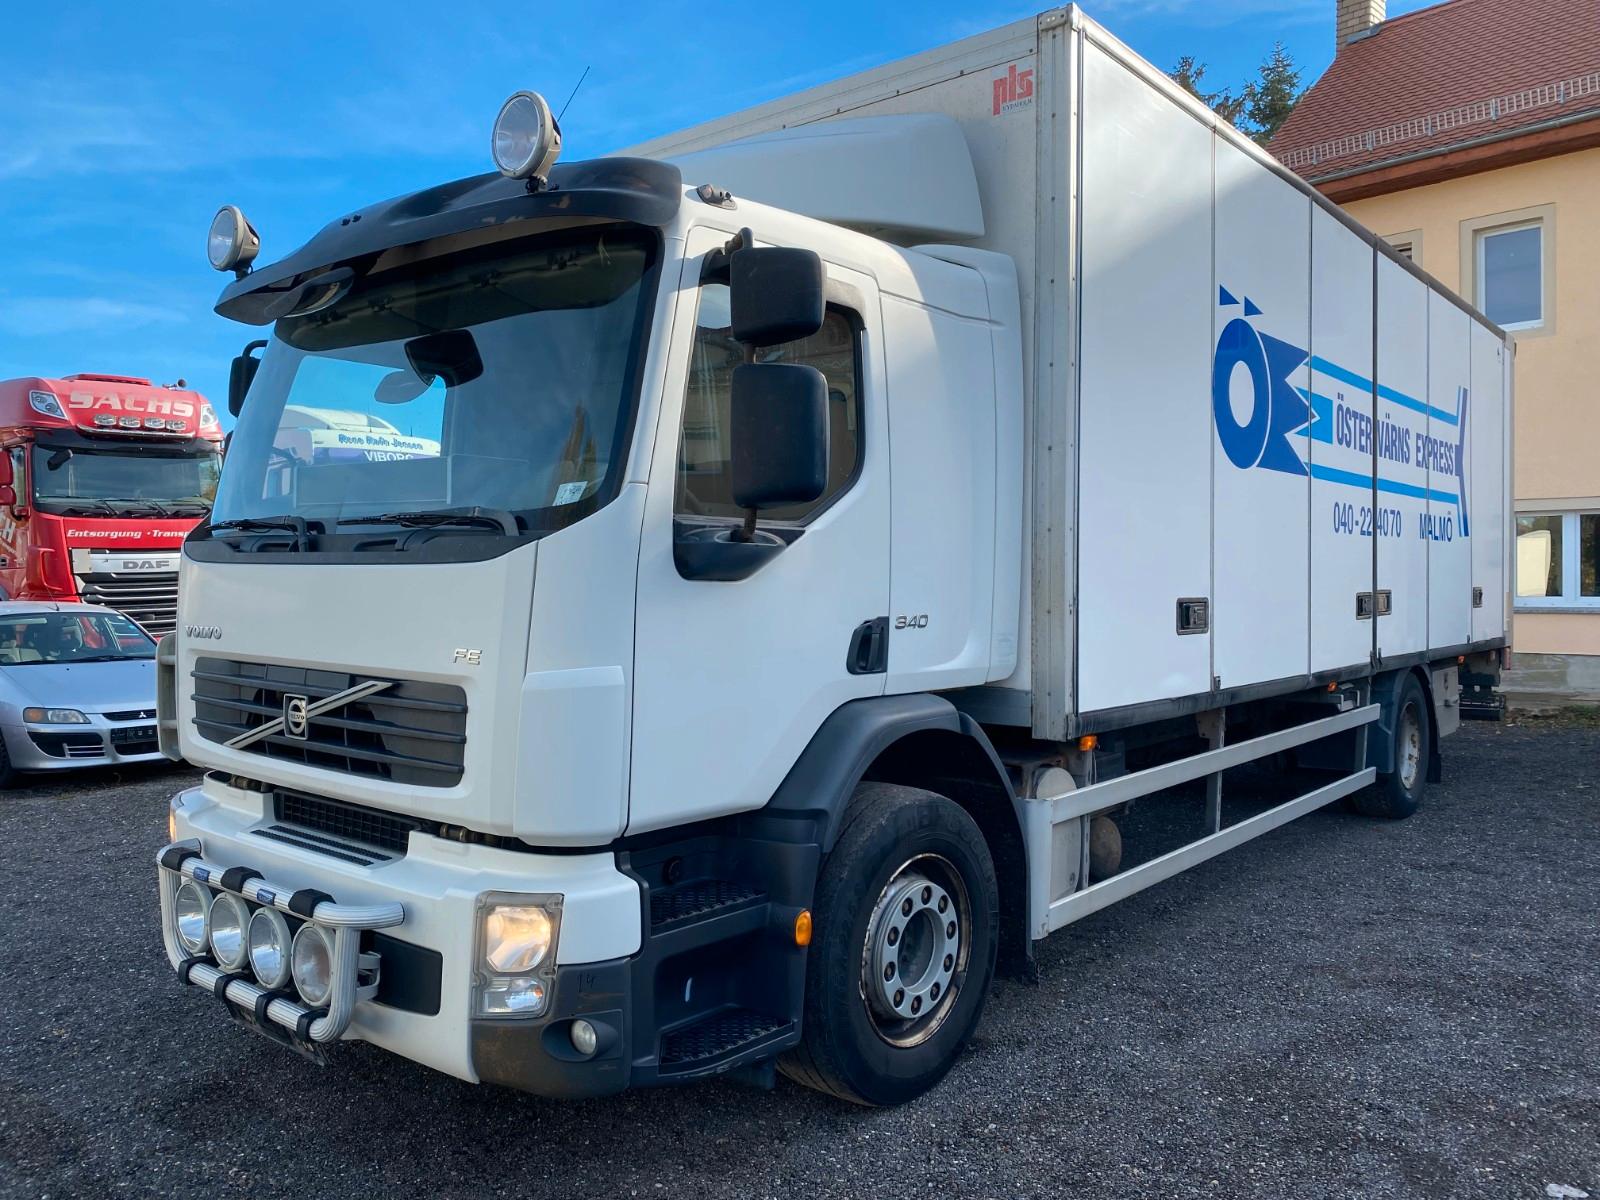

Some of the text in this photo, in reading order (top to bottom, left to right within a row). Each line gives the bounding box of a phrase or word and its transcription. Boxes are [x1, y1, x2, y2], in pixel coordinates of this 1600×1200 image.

[69, 390, 194, 417] SACHS
[1415, 432, 1454, 476] EXPRESS
[67, 529, 142, 539] Entsorgung
[1419, 510, 1453, 542] MALMÖ
[123, 560, 170, 570] DAF
[895, 614, 929, 630] 340
[185, 625, 222, 640] VOLVO
[453, 648, 482, 665] FE
